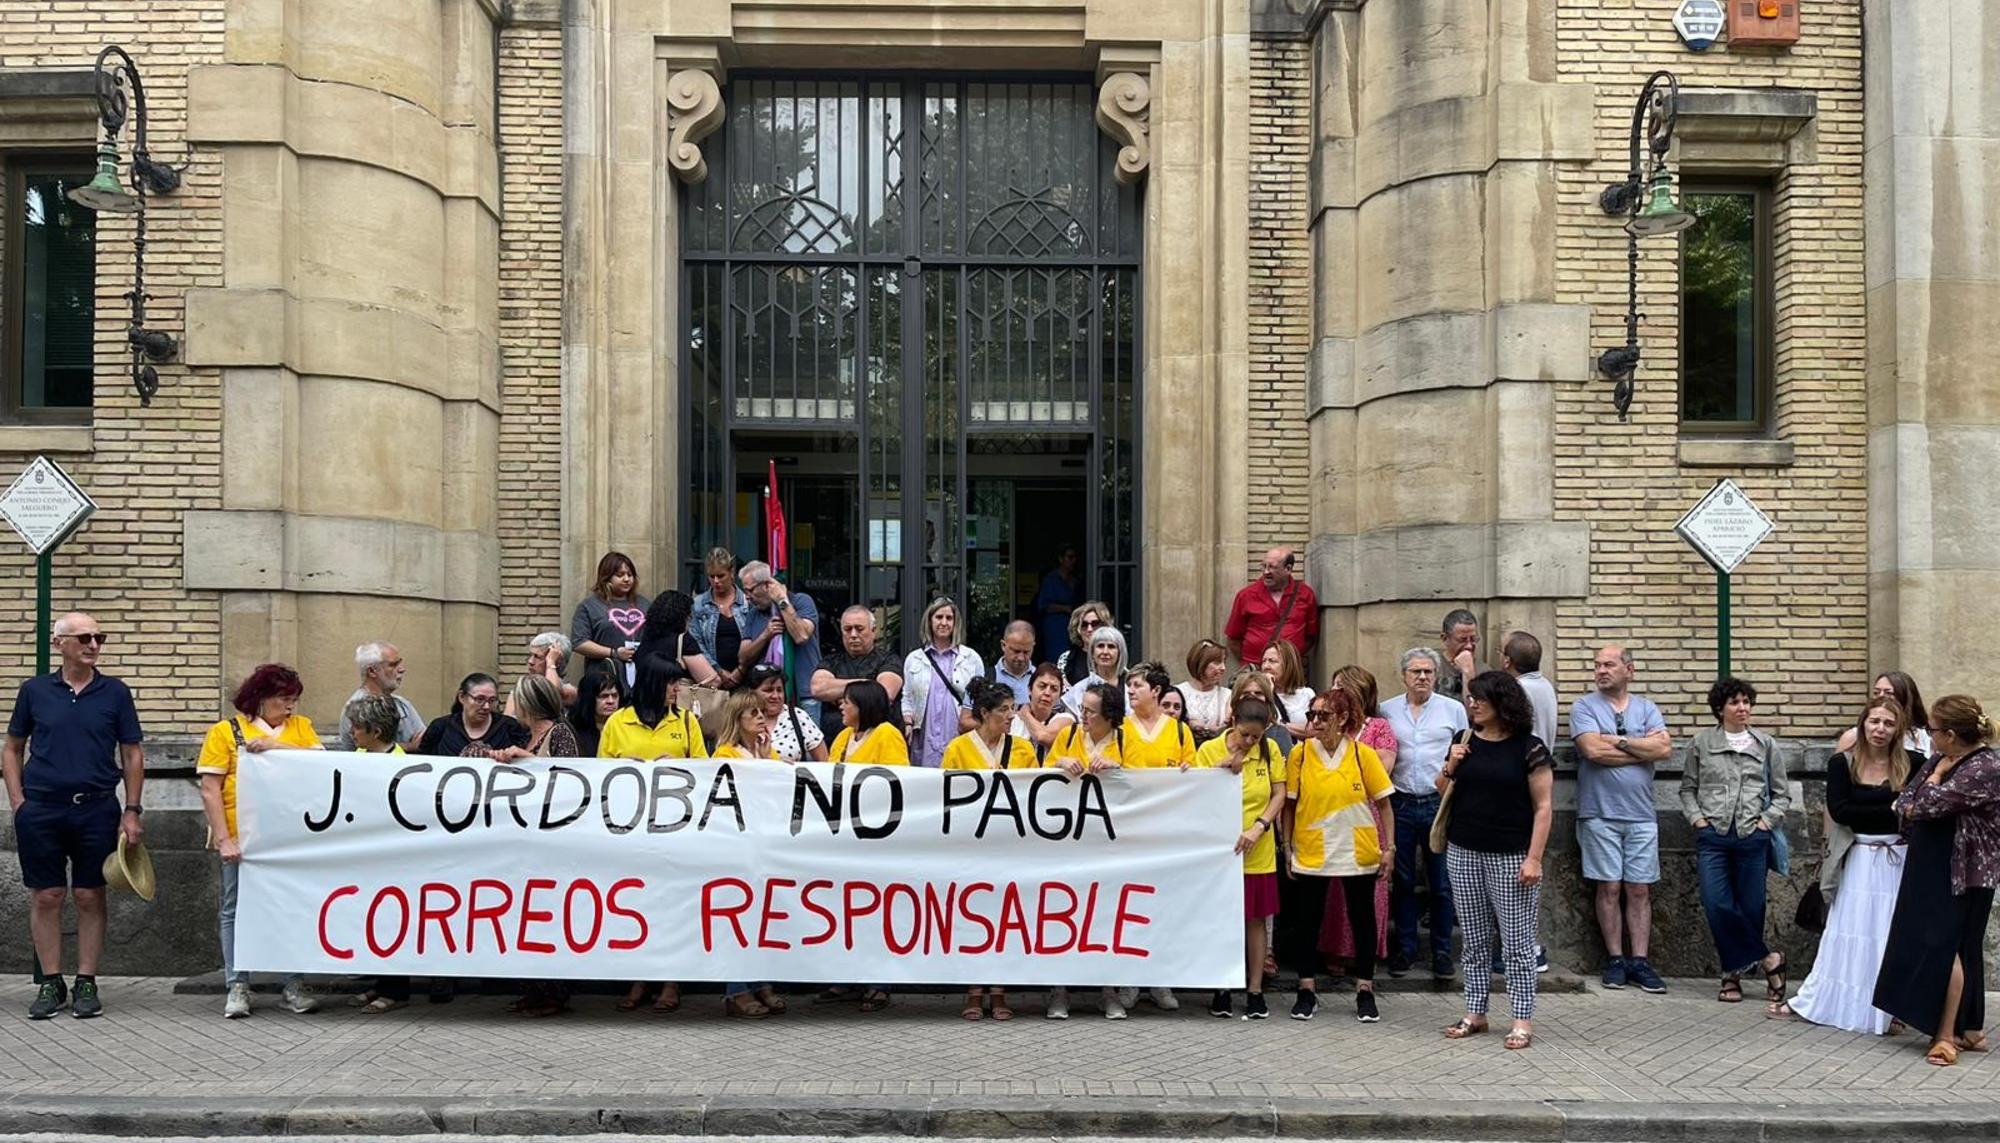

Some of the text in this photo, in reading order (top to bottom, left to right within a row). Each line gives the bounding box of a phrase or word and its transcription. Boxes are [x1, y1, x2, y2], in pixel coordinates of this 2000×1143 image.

[805, 579, 848, 588] ENTRADA
[304, 763, 1117, 842] J. CORDOBA NO PAGA
[318, 877, 1156, 959] CORREOS RESPONSABLE
